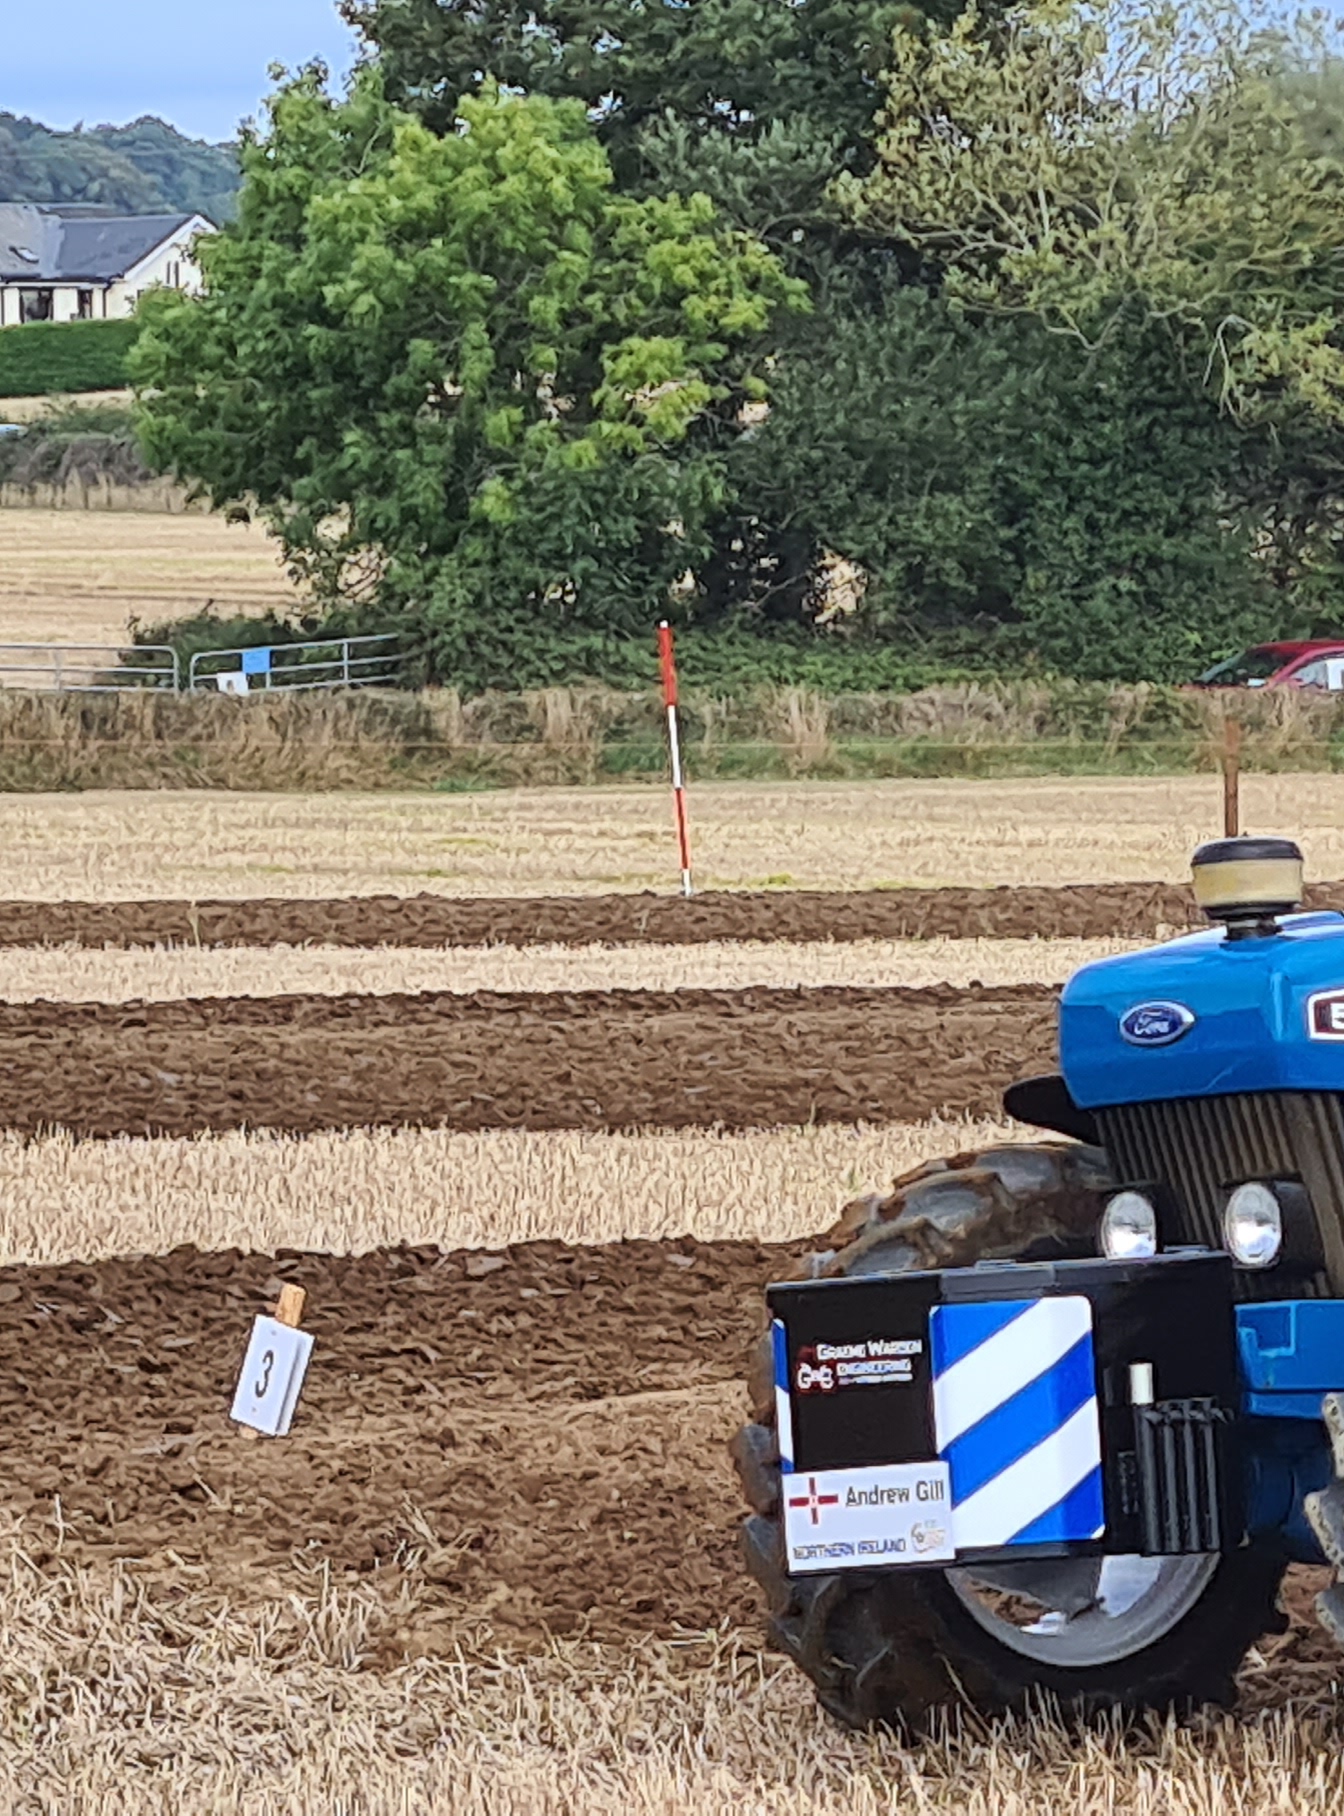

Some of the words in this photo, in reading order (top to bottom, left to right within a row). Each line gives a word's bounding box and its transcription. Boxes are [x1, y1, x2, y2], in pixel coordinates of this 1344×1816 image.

[255, 1350, 274, 1399] 3
[846, 1485, 910, 1507] Andrew
[916, 1479, 945, 1501] Gill
